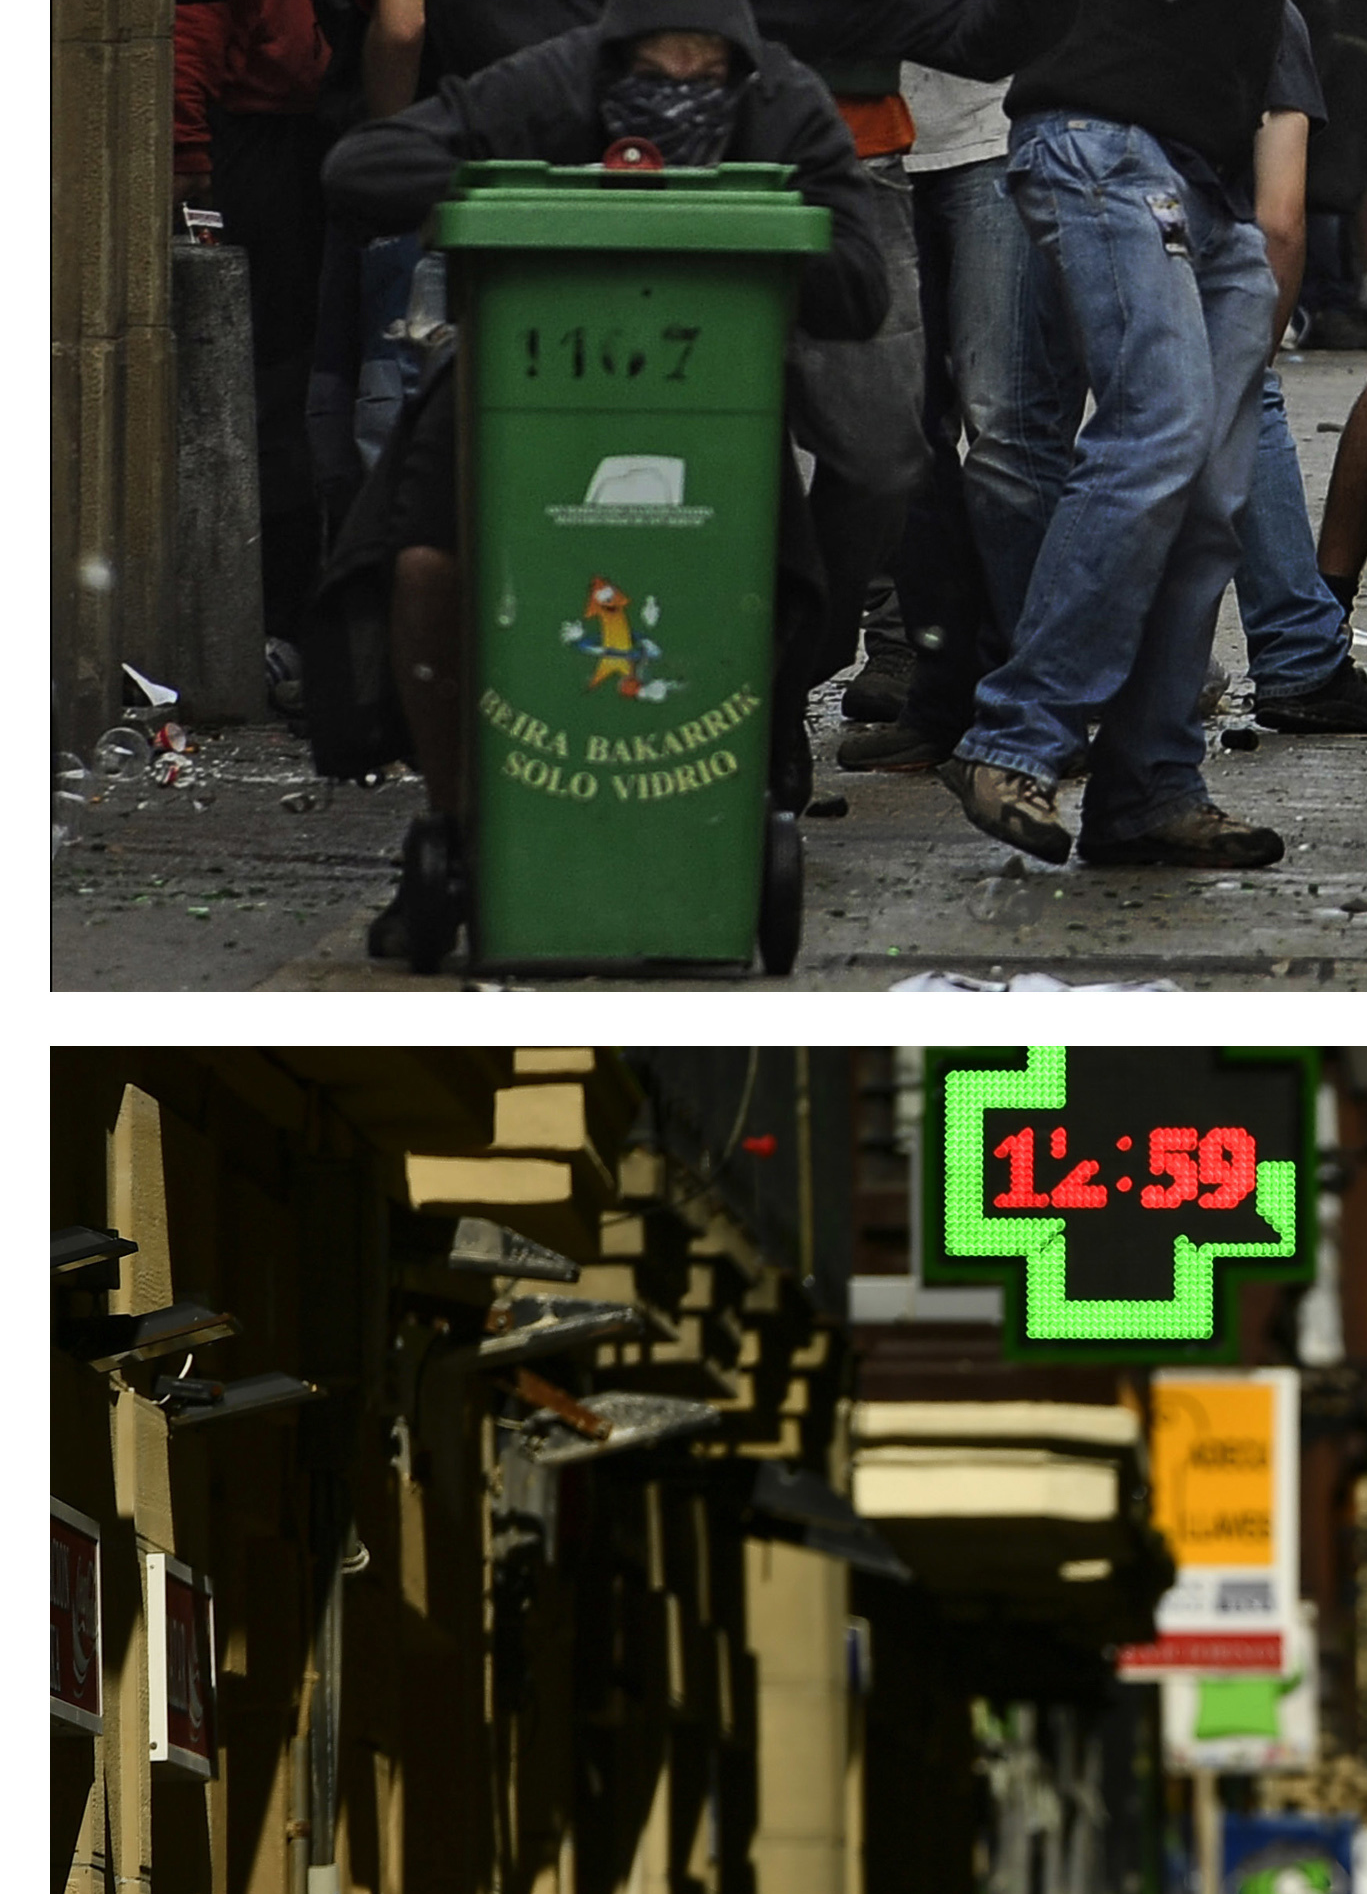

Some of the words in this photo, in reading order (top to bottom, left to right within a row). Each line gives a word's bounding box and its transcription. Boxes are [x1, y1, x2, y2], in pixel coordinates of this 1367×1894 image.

[588, 686, 763, 765] BAKARRIK
[505, 749, 598, 803] SOLO
[612, 748, 738, 803] VIDRIO
